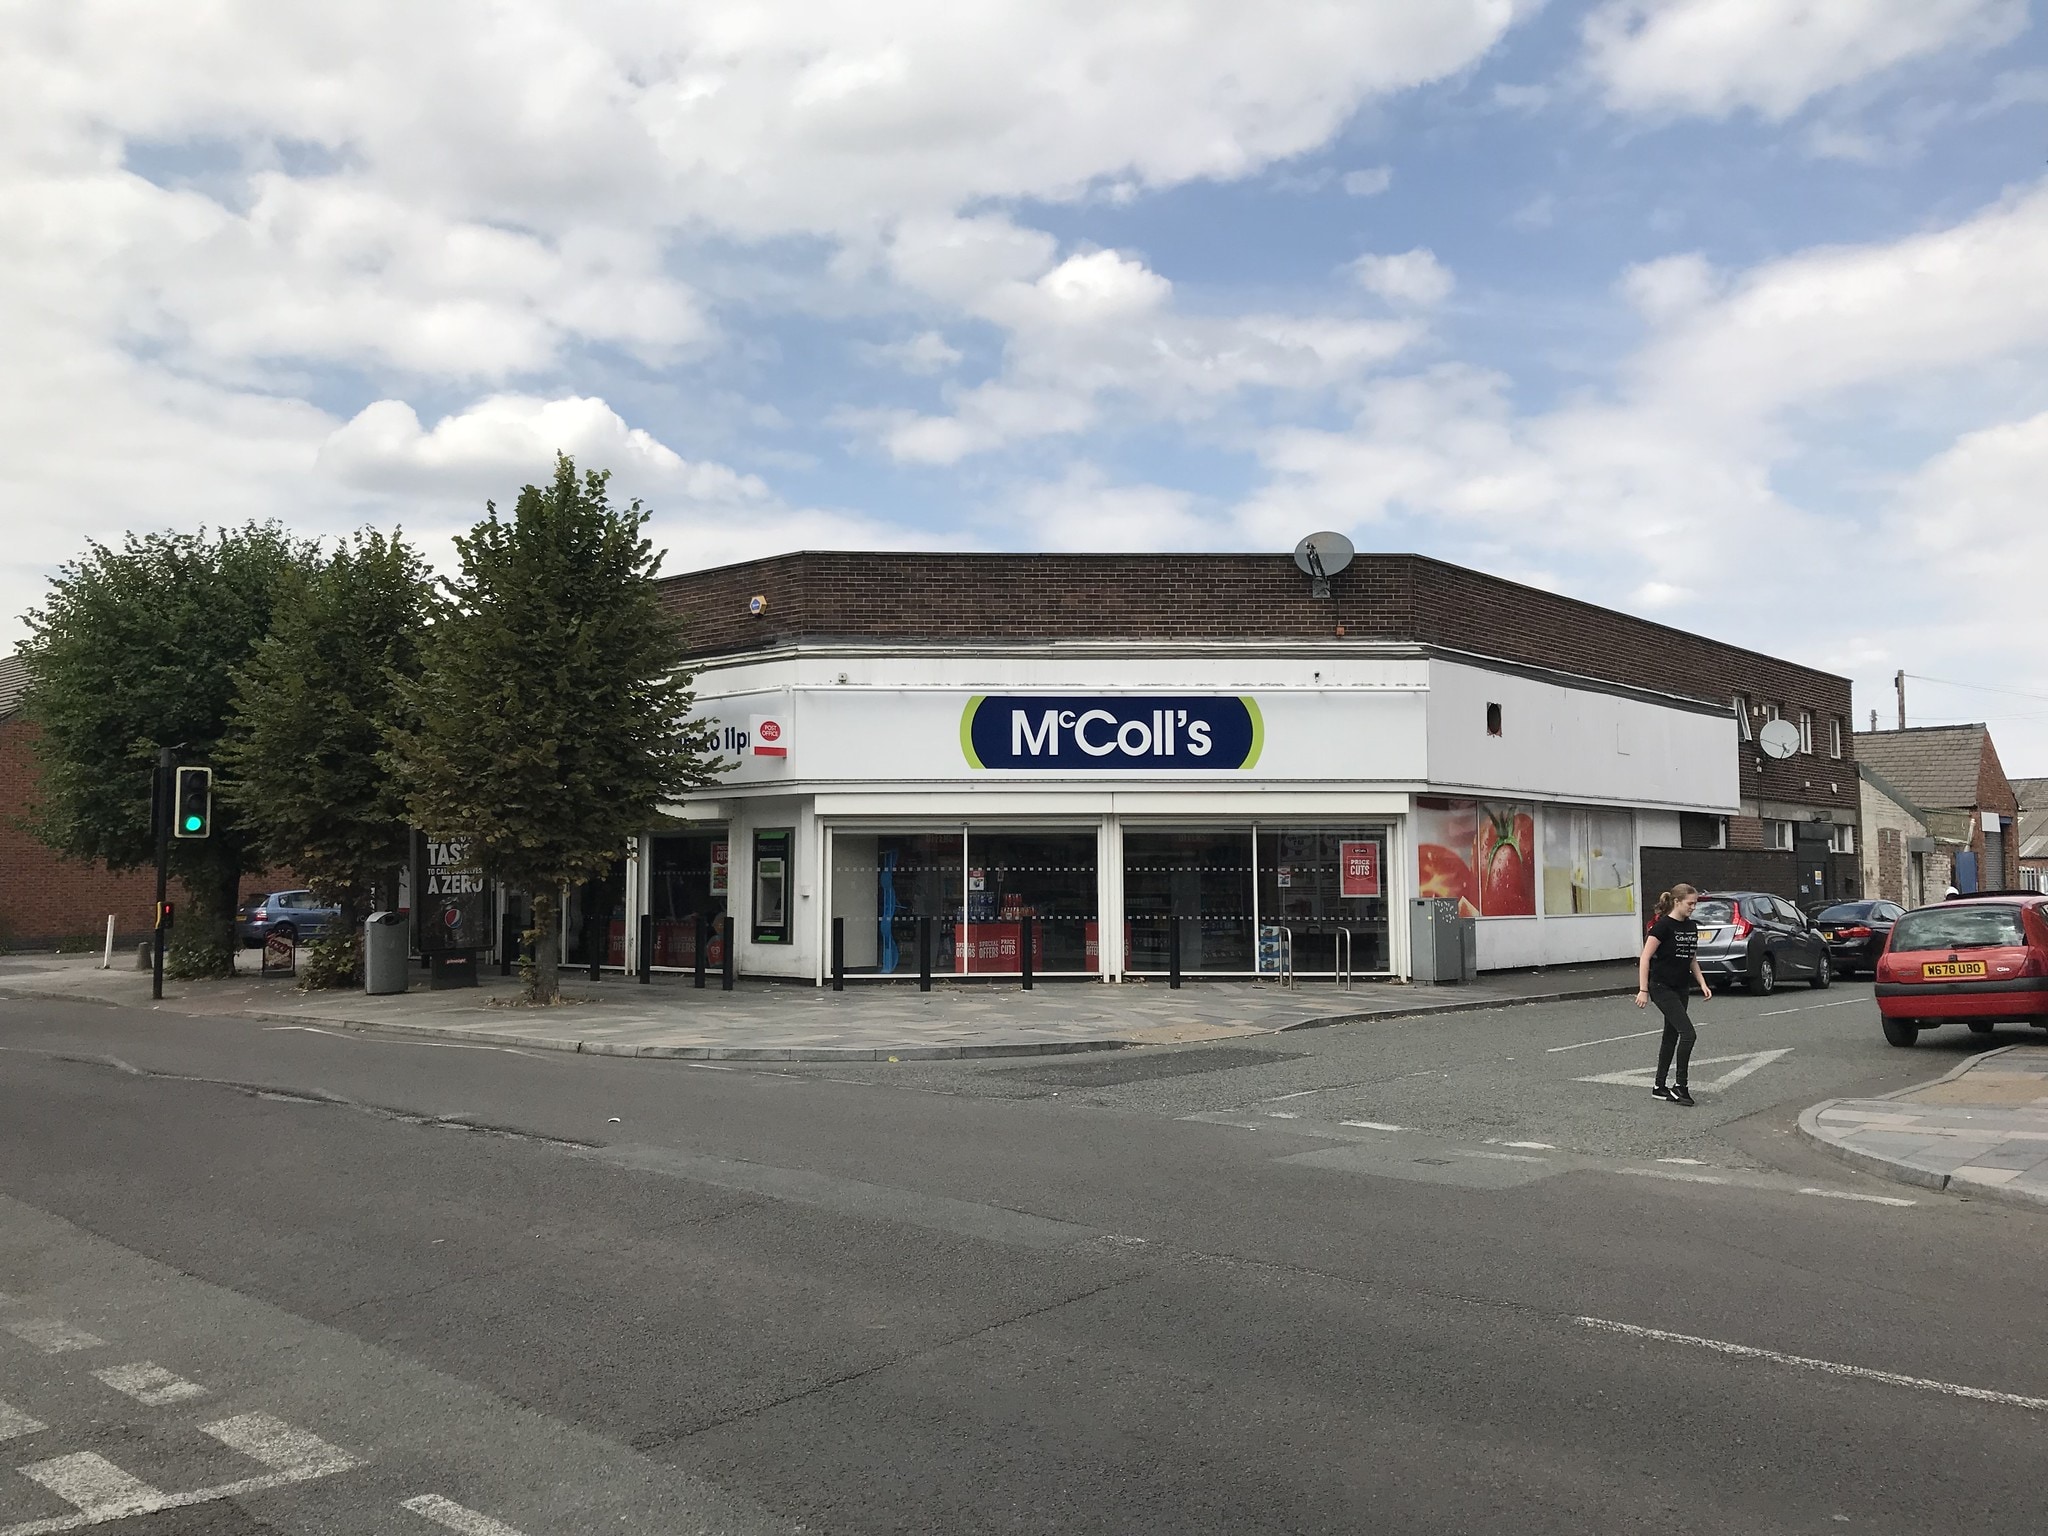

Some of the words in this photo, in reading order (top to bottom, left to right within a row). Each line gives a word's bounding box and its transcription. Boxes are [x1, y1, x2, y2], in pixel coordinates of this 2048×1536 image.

[1012, 709, 1212, 756] McColl's
[1350, 865, 1370, 876] CUTS
[428, 876, 438, 894] A
[442, 875, 483, 894] ZERO
[979, 946, 999, 958] OFFERS
[1001, 945, 1016, 955] CUTS
